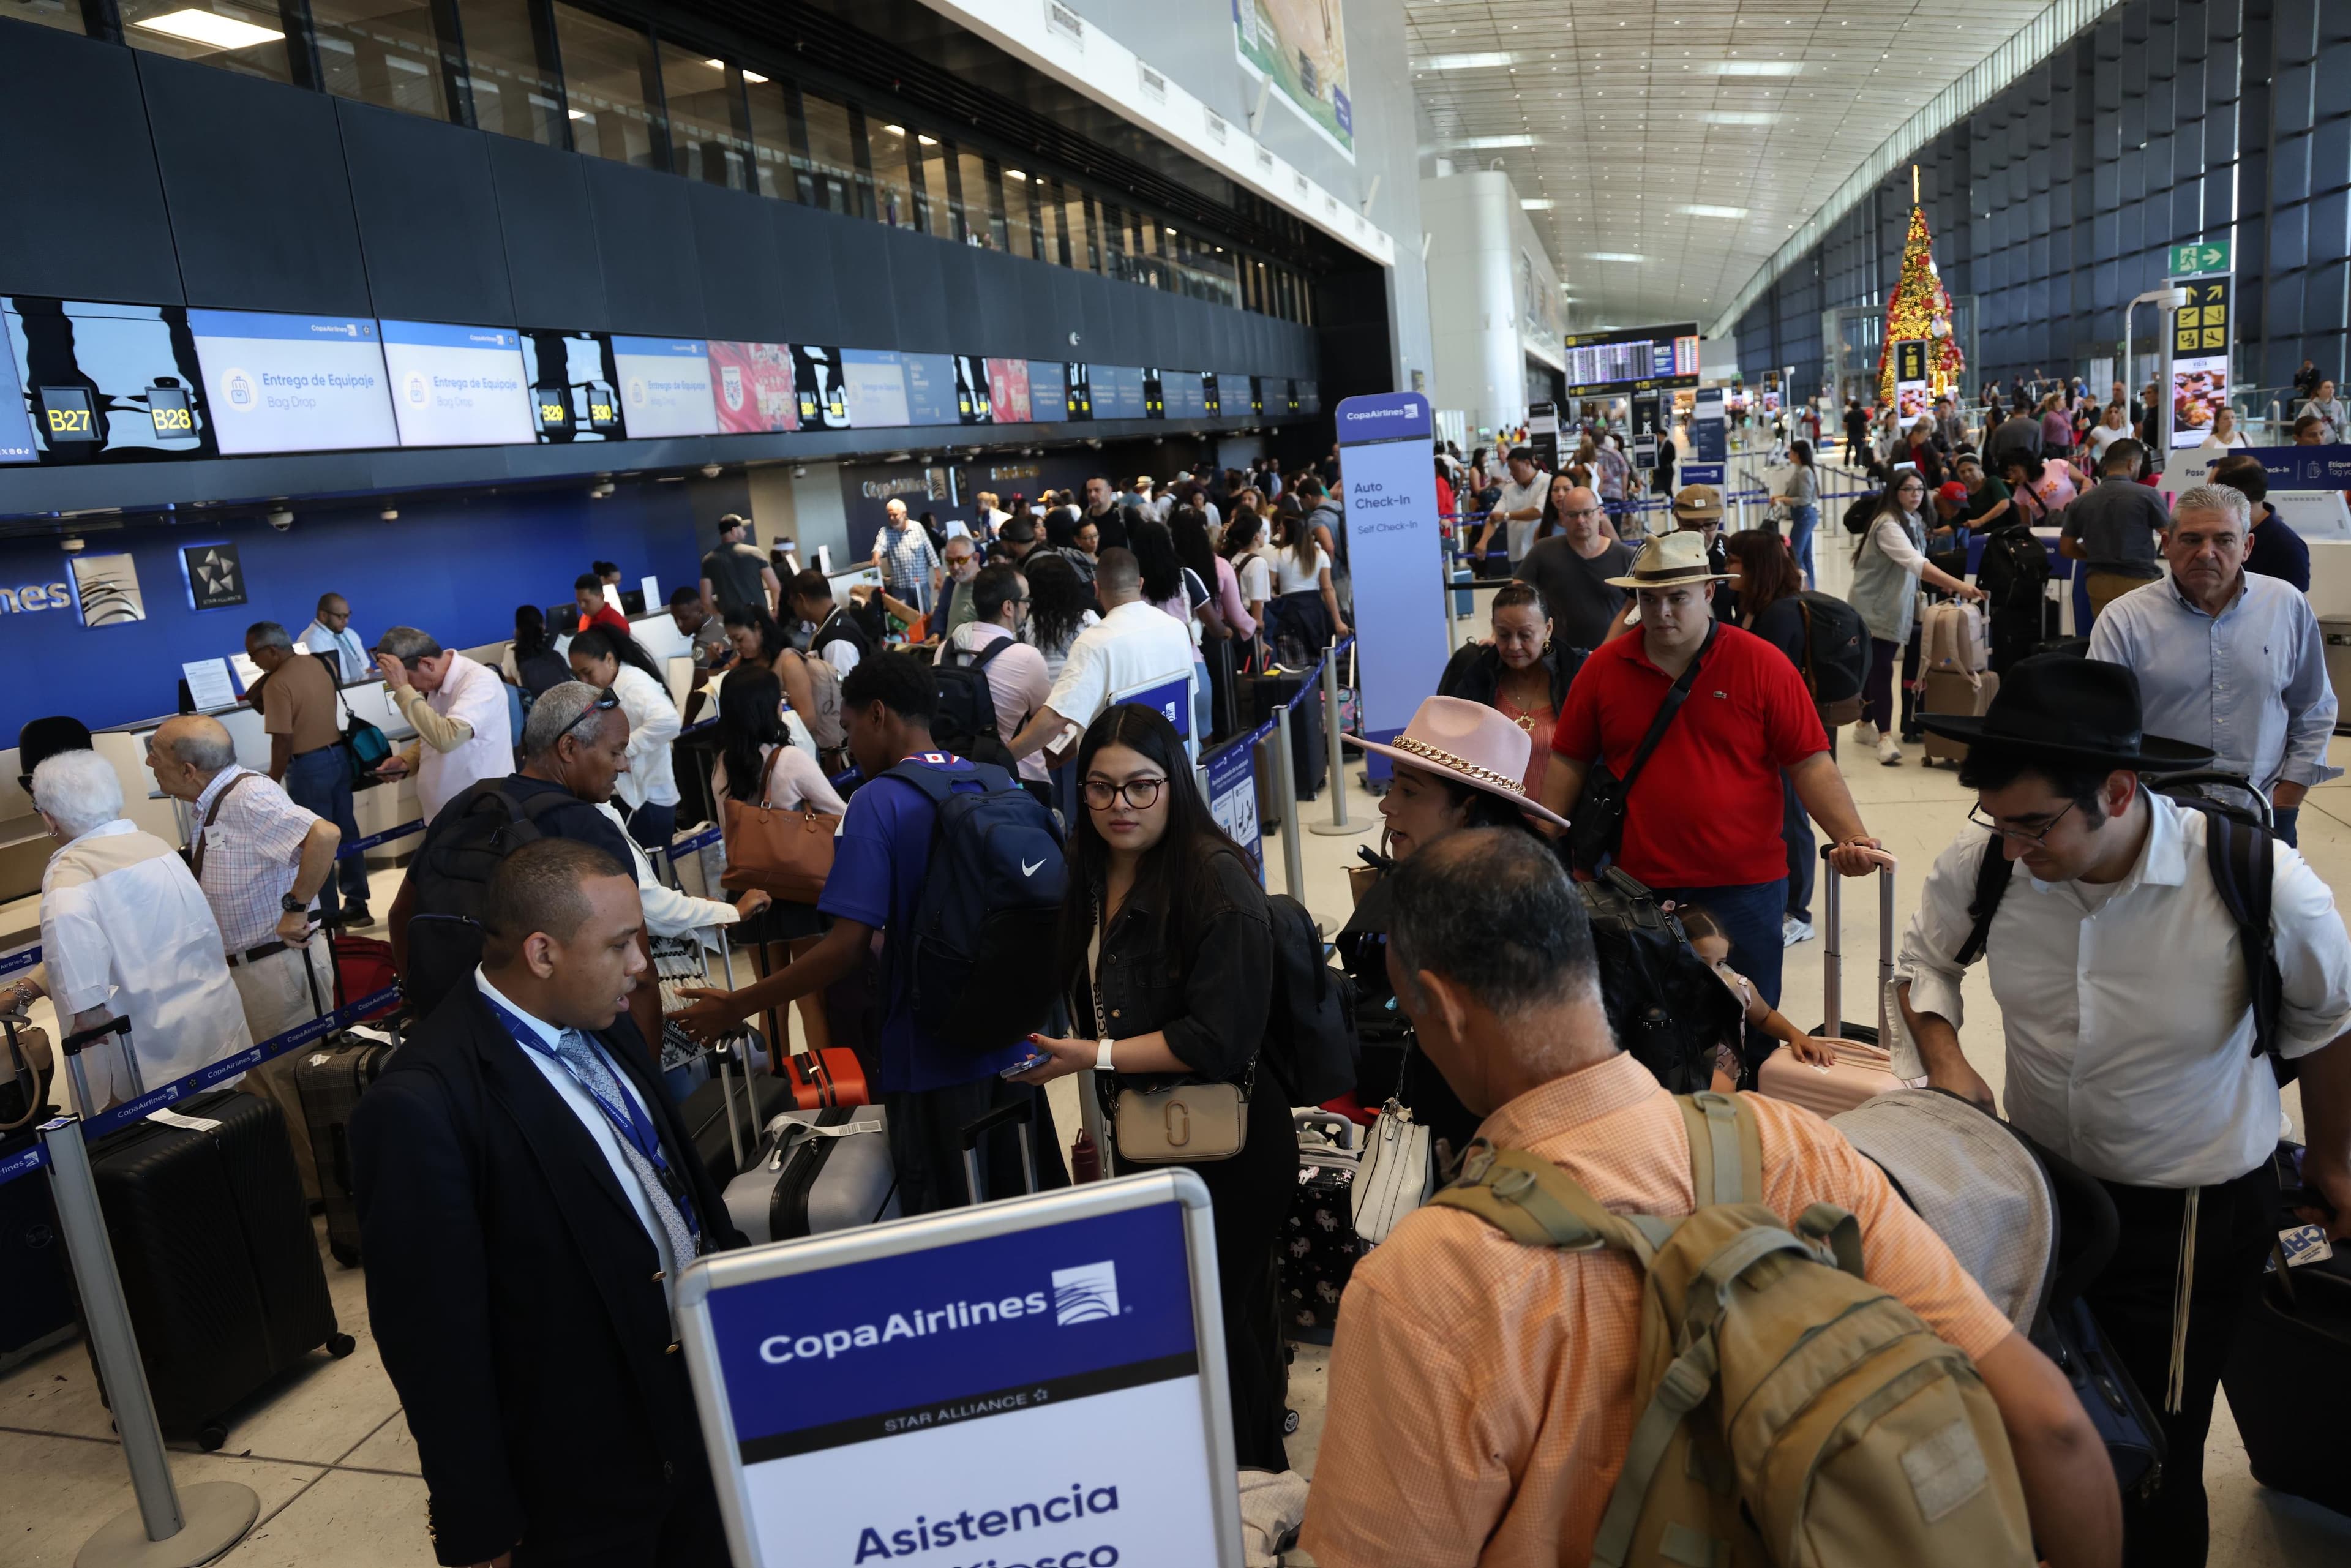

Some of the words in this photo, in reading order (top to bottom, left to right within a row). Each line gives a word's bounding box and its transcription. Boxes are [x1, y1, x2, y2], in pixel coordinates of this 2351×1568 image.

[262, 373, 309, 389] Entrega
[311, 374, 326, 386] de
[328, 374, 375, 388] Equipaje
[433, 375, 468, 390] Entrega
[470, 377, 481, 388] de
[482, 377, 518, 391] Equipaje
[267, 396, 290, 410] Bag
[290, 396, 317, 410] Drop
[48, 410, 90, 432] B27
[152, 408, 192, 430] B28
[1346, 408, 1404, 421] CopaAirlines
[2329, 468, 2342, 477] Tag
[1354, 482, 1383, 494] Auto
[1355, 494, 1411, 510] Check-In
[1357, 523, 1375, 535] Self
[1376, 520, 1419, 533] Check-In
[358, 992, 393, 1011] CopaAirlines
[287, 1022, 326, 1043] CopaAirlines
[207, 1056, 251, 1078] CopaAirlines
[117, 1093, 167, 1118] CopaAirlines
[759, 1291, 1048, 1364] CopaAirlines
[884, 1411, 932, 1433] STAR
[937, 1392, 1027, 1420] ALLIANCE
[853, 1483, 1119, 1566] Asistencia
